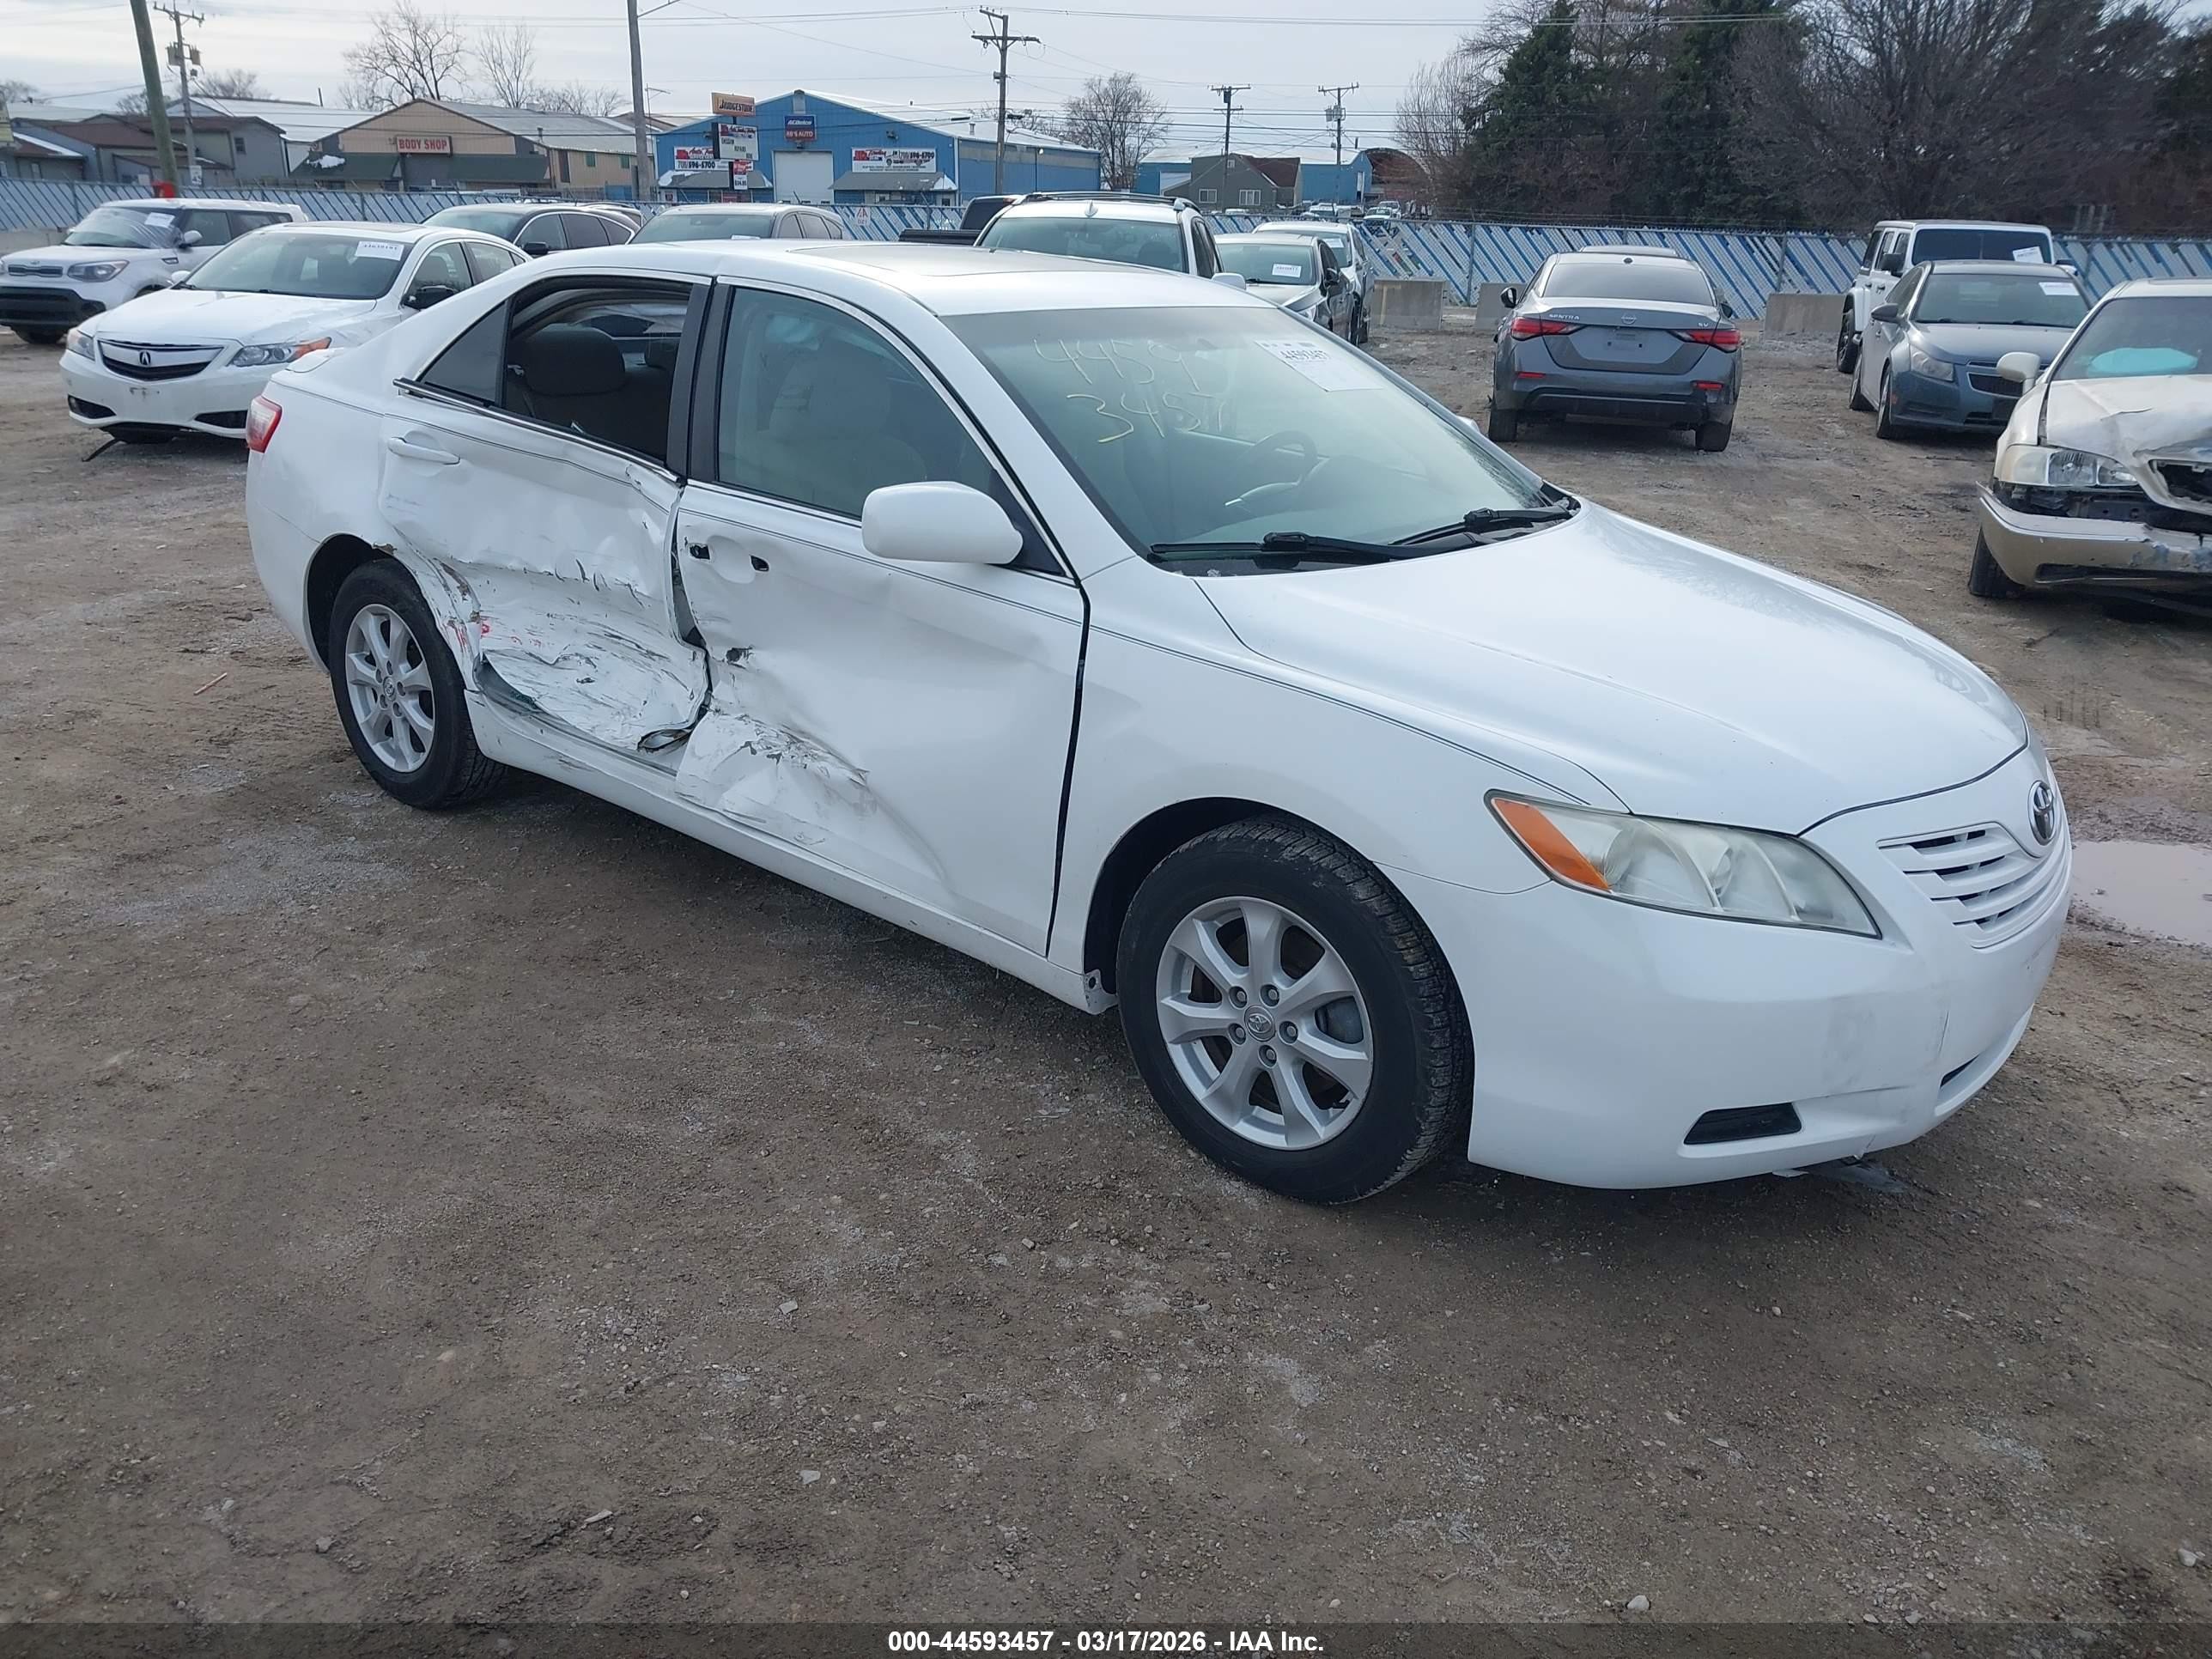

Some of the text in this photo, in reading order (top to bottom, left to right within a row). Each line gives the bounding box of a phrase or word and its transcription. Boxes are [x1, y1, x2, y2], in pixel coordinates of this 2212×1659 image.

[398, 138, 447, 150] BODY SHOP
[1032, 338, 1201, 392] 4459
[1066, 392, 1227, 444] 3457
